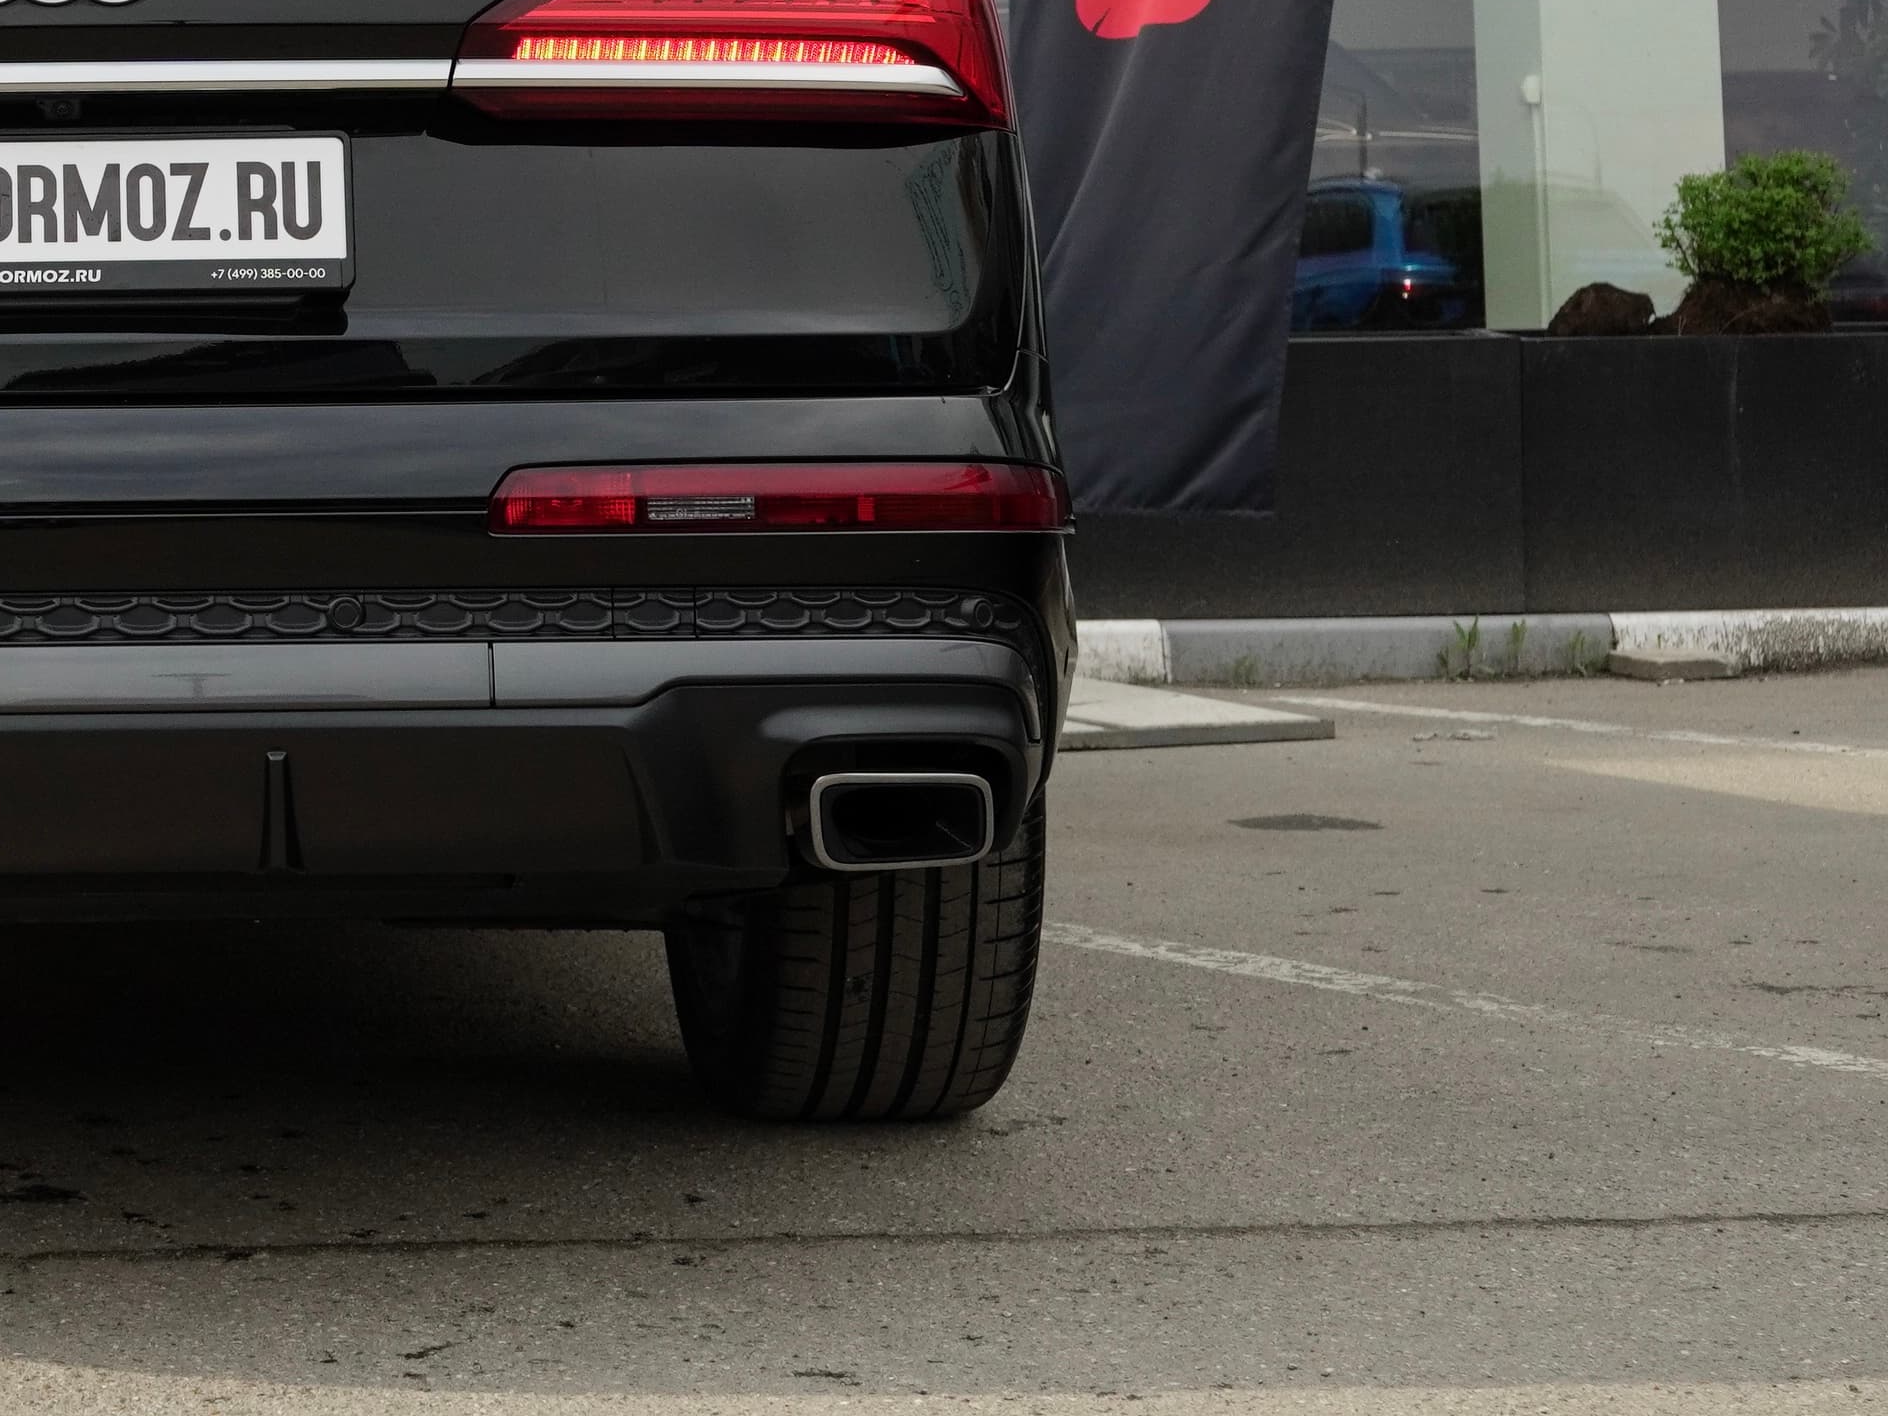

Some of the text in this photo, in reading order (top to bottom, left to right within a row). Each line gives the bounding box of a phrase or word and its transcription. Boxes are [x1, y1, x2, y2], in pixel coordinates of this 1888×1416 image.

[211, 268, 326, 280] +7 (499) 385-00-00
